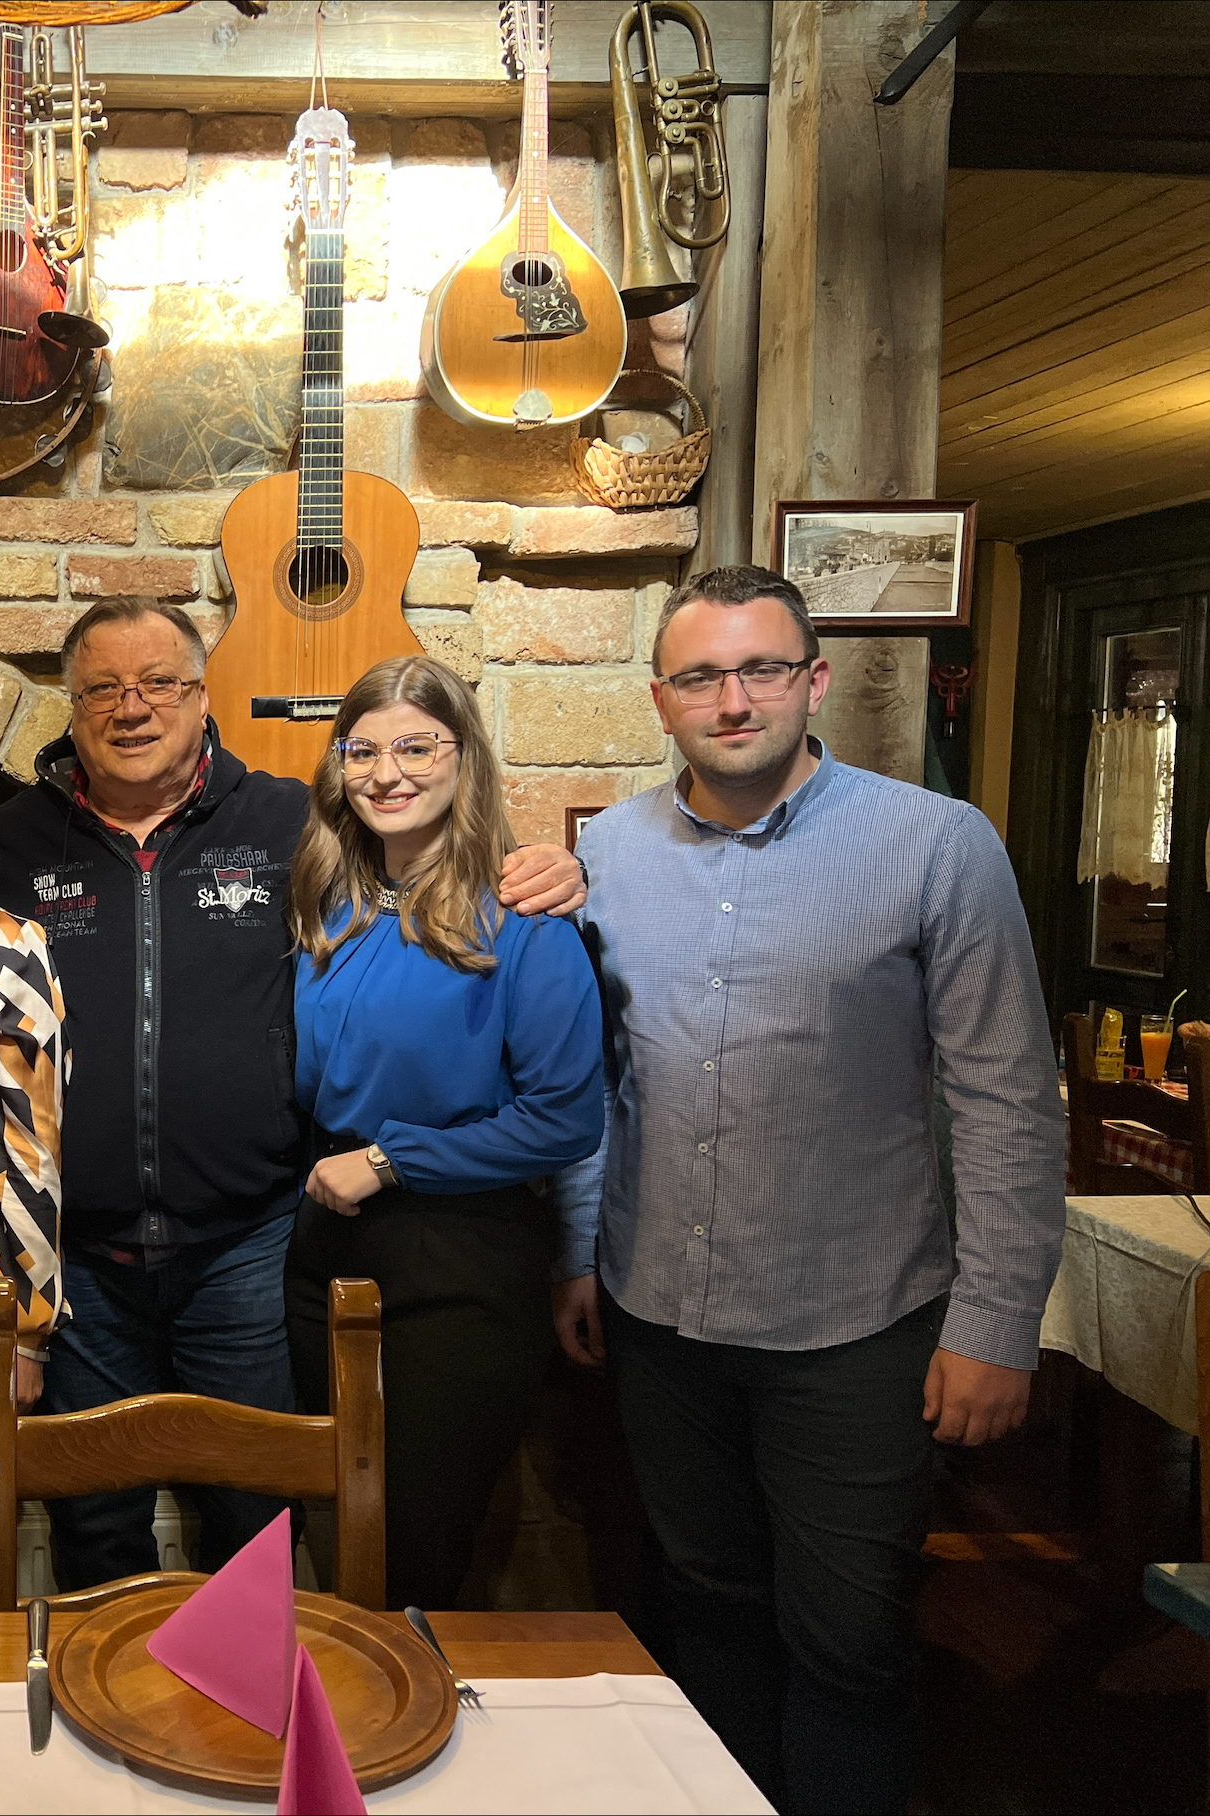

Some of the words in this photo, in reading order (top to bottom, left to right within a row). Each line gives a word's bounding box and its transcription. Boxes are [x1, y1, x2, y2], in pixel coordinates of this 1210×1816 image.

[200, 849, 270, 867] PAUL&SHARK
[33, 873, 56, 890] SNOW
[37, 886, 60, 902] TEAM
[62, 881, 83, 899] CLUB
[77, 895, 97, 908] CLUB
[74, 927, 98, 936] TEAM
